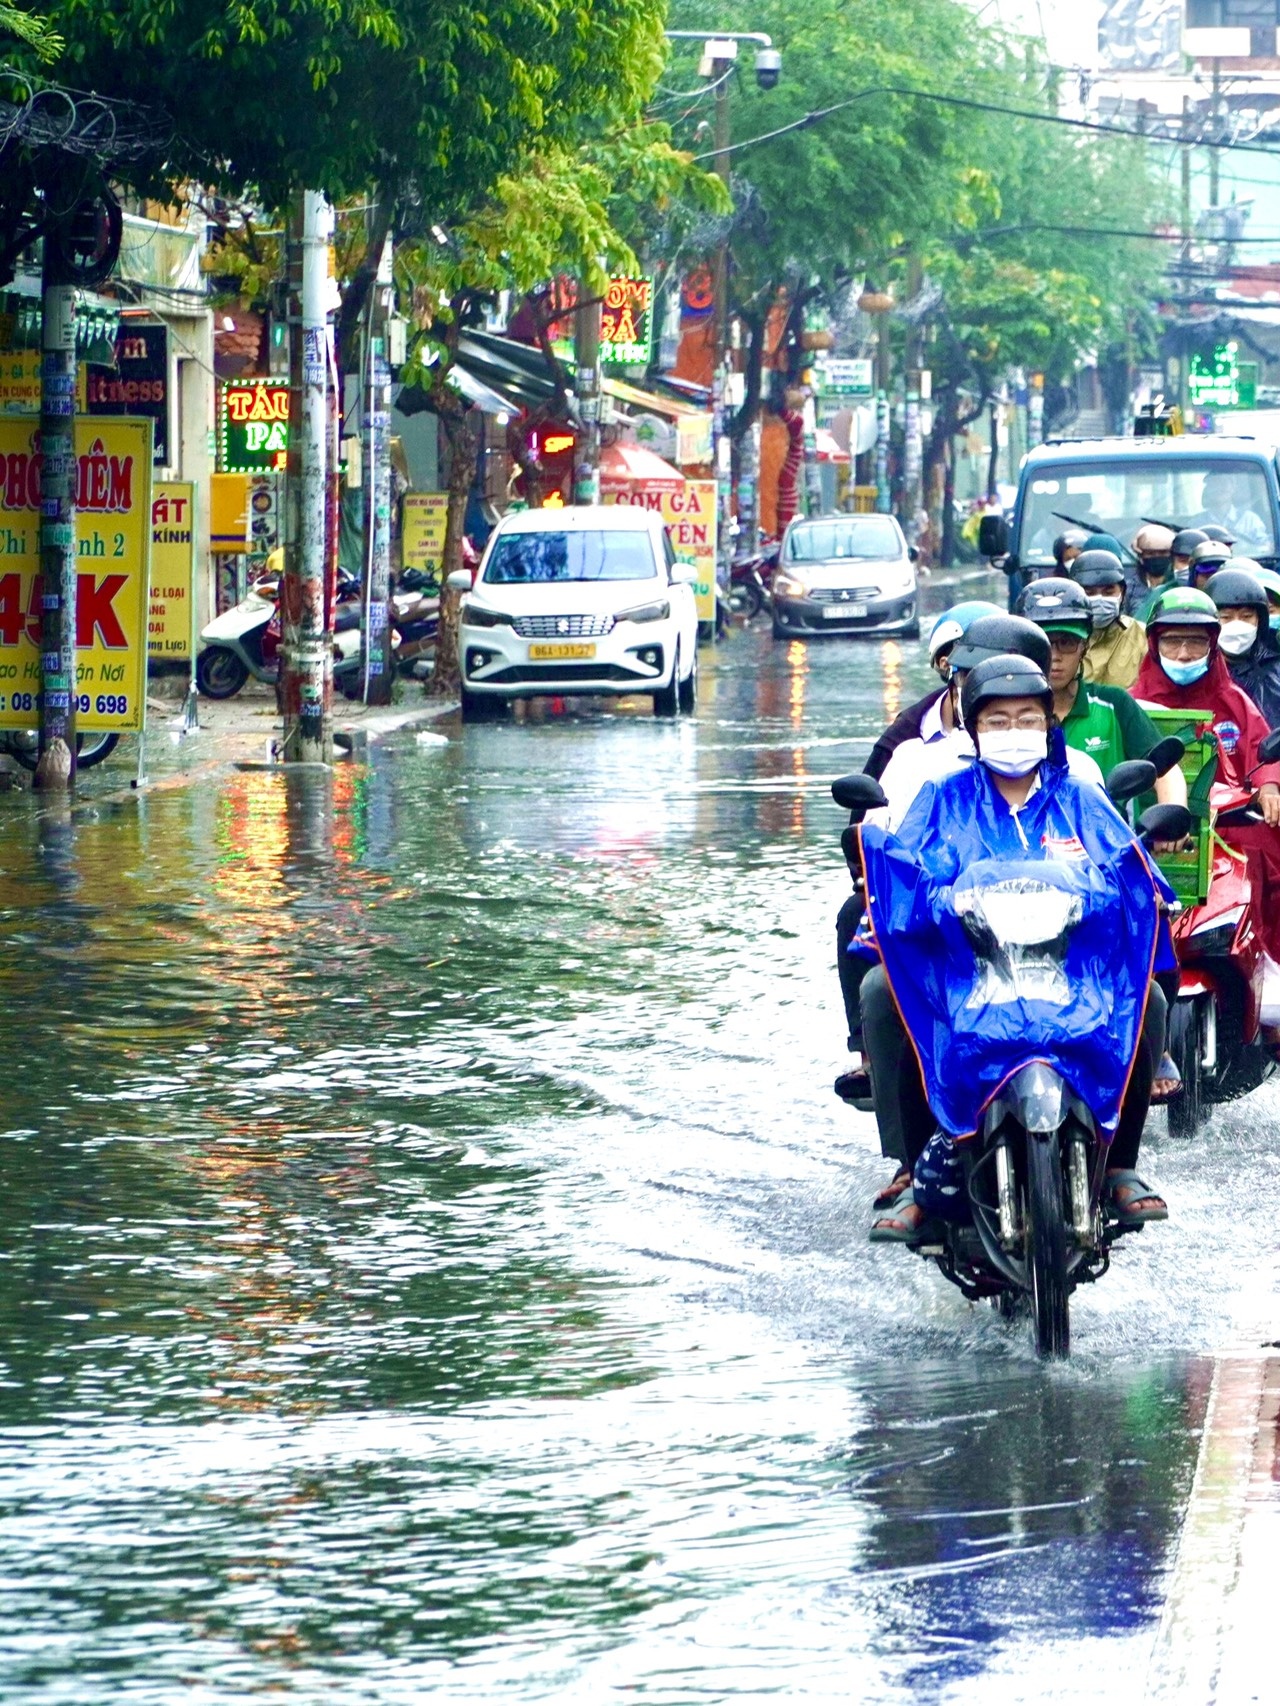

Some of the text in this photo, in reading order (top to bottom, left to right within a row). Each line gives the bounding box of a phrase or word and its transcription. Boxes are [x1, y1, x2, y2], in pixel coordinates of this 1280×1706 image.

[113, 533, 125, 556] 2
[153, 528, 191, 543] KÍNH
[163, 588, 184, 600] LOẠI
[100, 664, 125, 682] Nơi
[96, 695, 127, 714] 698
